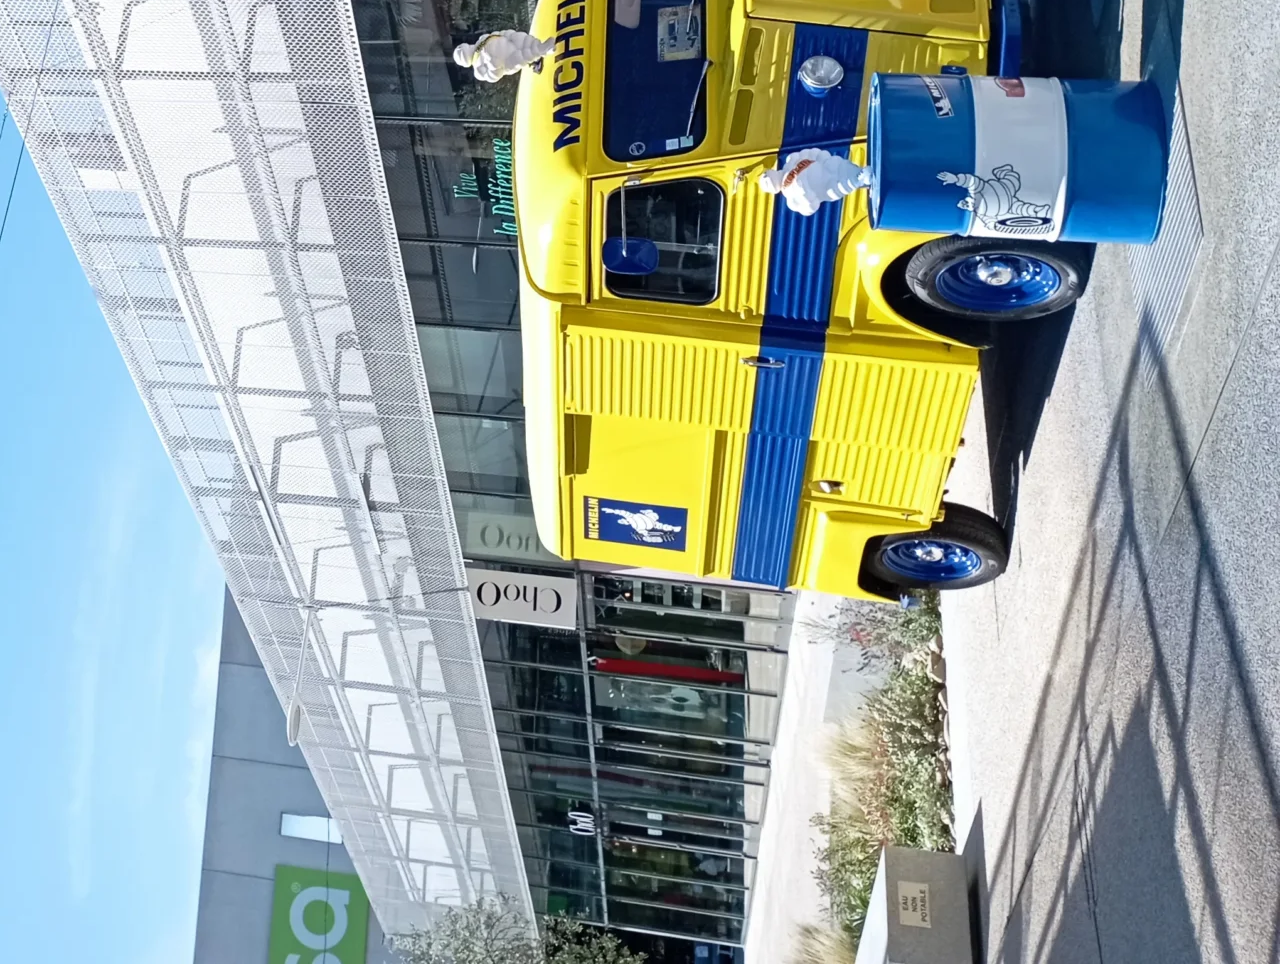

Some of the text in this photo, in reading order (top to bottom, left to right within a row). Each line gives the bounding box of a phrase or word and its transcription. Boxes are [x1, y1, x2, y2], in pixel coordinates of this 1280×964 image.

[452, 172, 478, 198] Vive
[487, 137, 518, 236] la Différence
[588, 498, 600, 539] MICHELIN
[476, 580, 562, 614] ChoO
[901, 895, 909, 911] EAU
[919, 889, 928, 923] POTABLE
[285, 886, 351, 964] a
